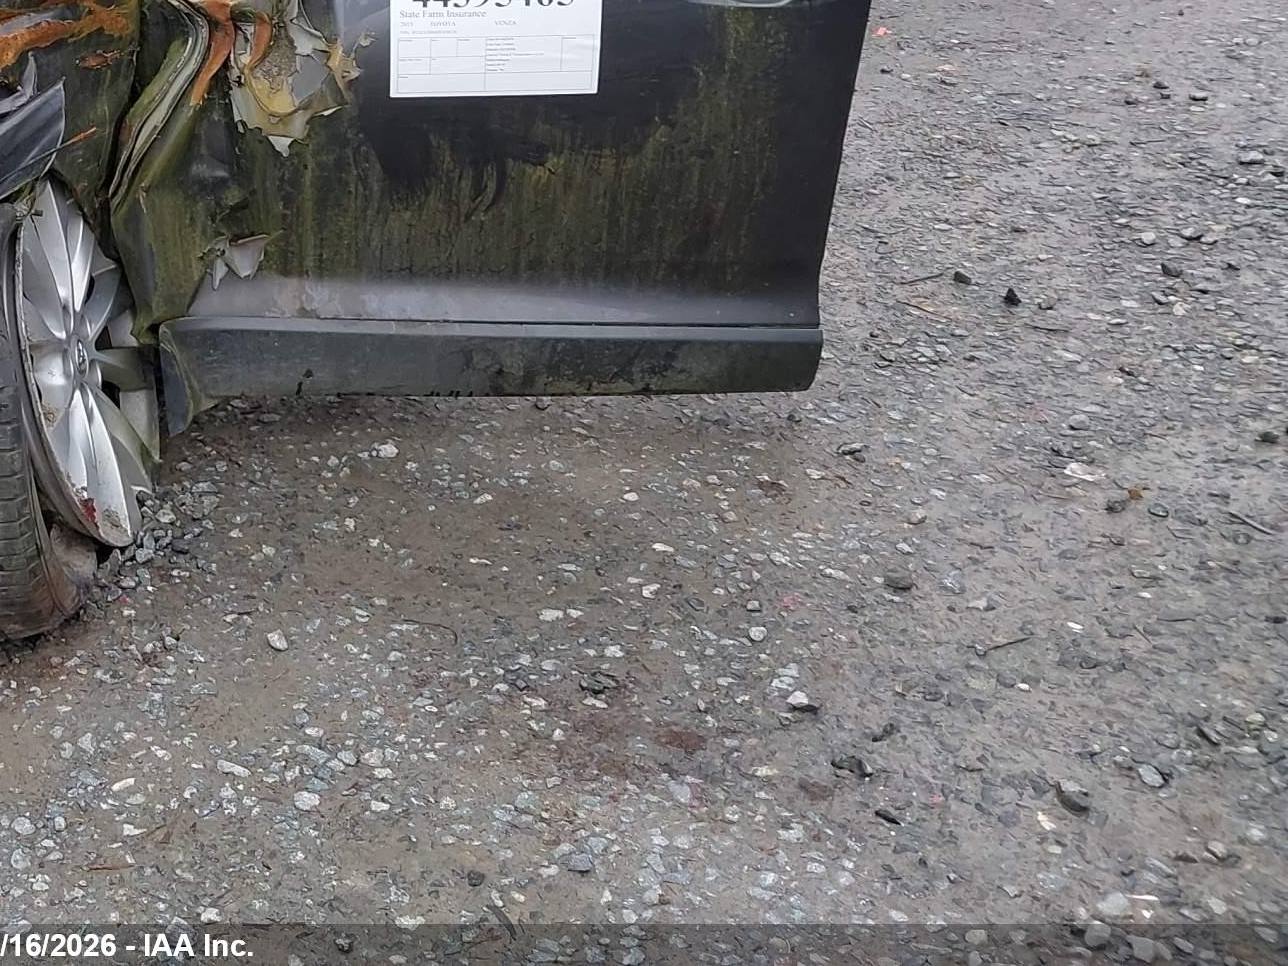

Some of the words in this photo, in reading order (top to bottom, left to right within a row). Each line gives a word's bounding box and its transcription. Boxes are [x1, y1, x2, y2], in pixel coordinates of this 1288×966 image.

[399, 10, 421, 19] State
[422, 10, 444, 19] Farm
[446, 9, 487, 19] Insurance
